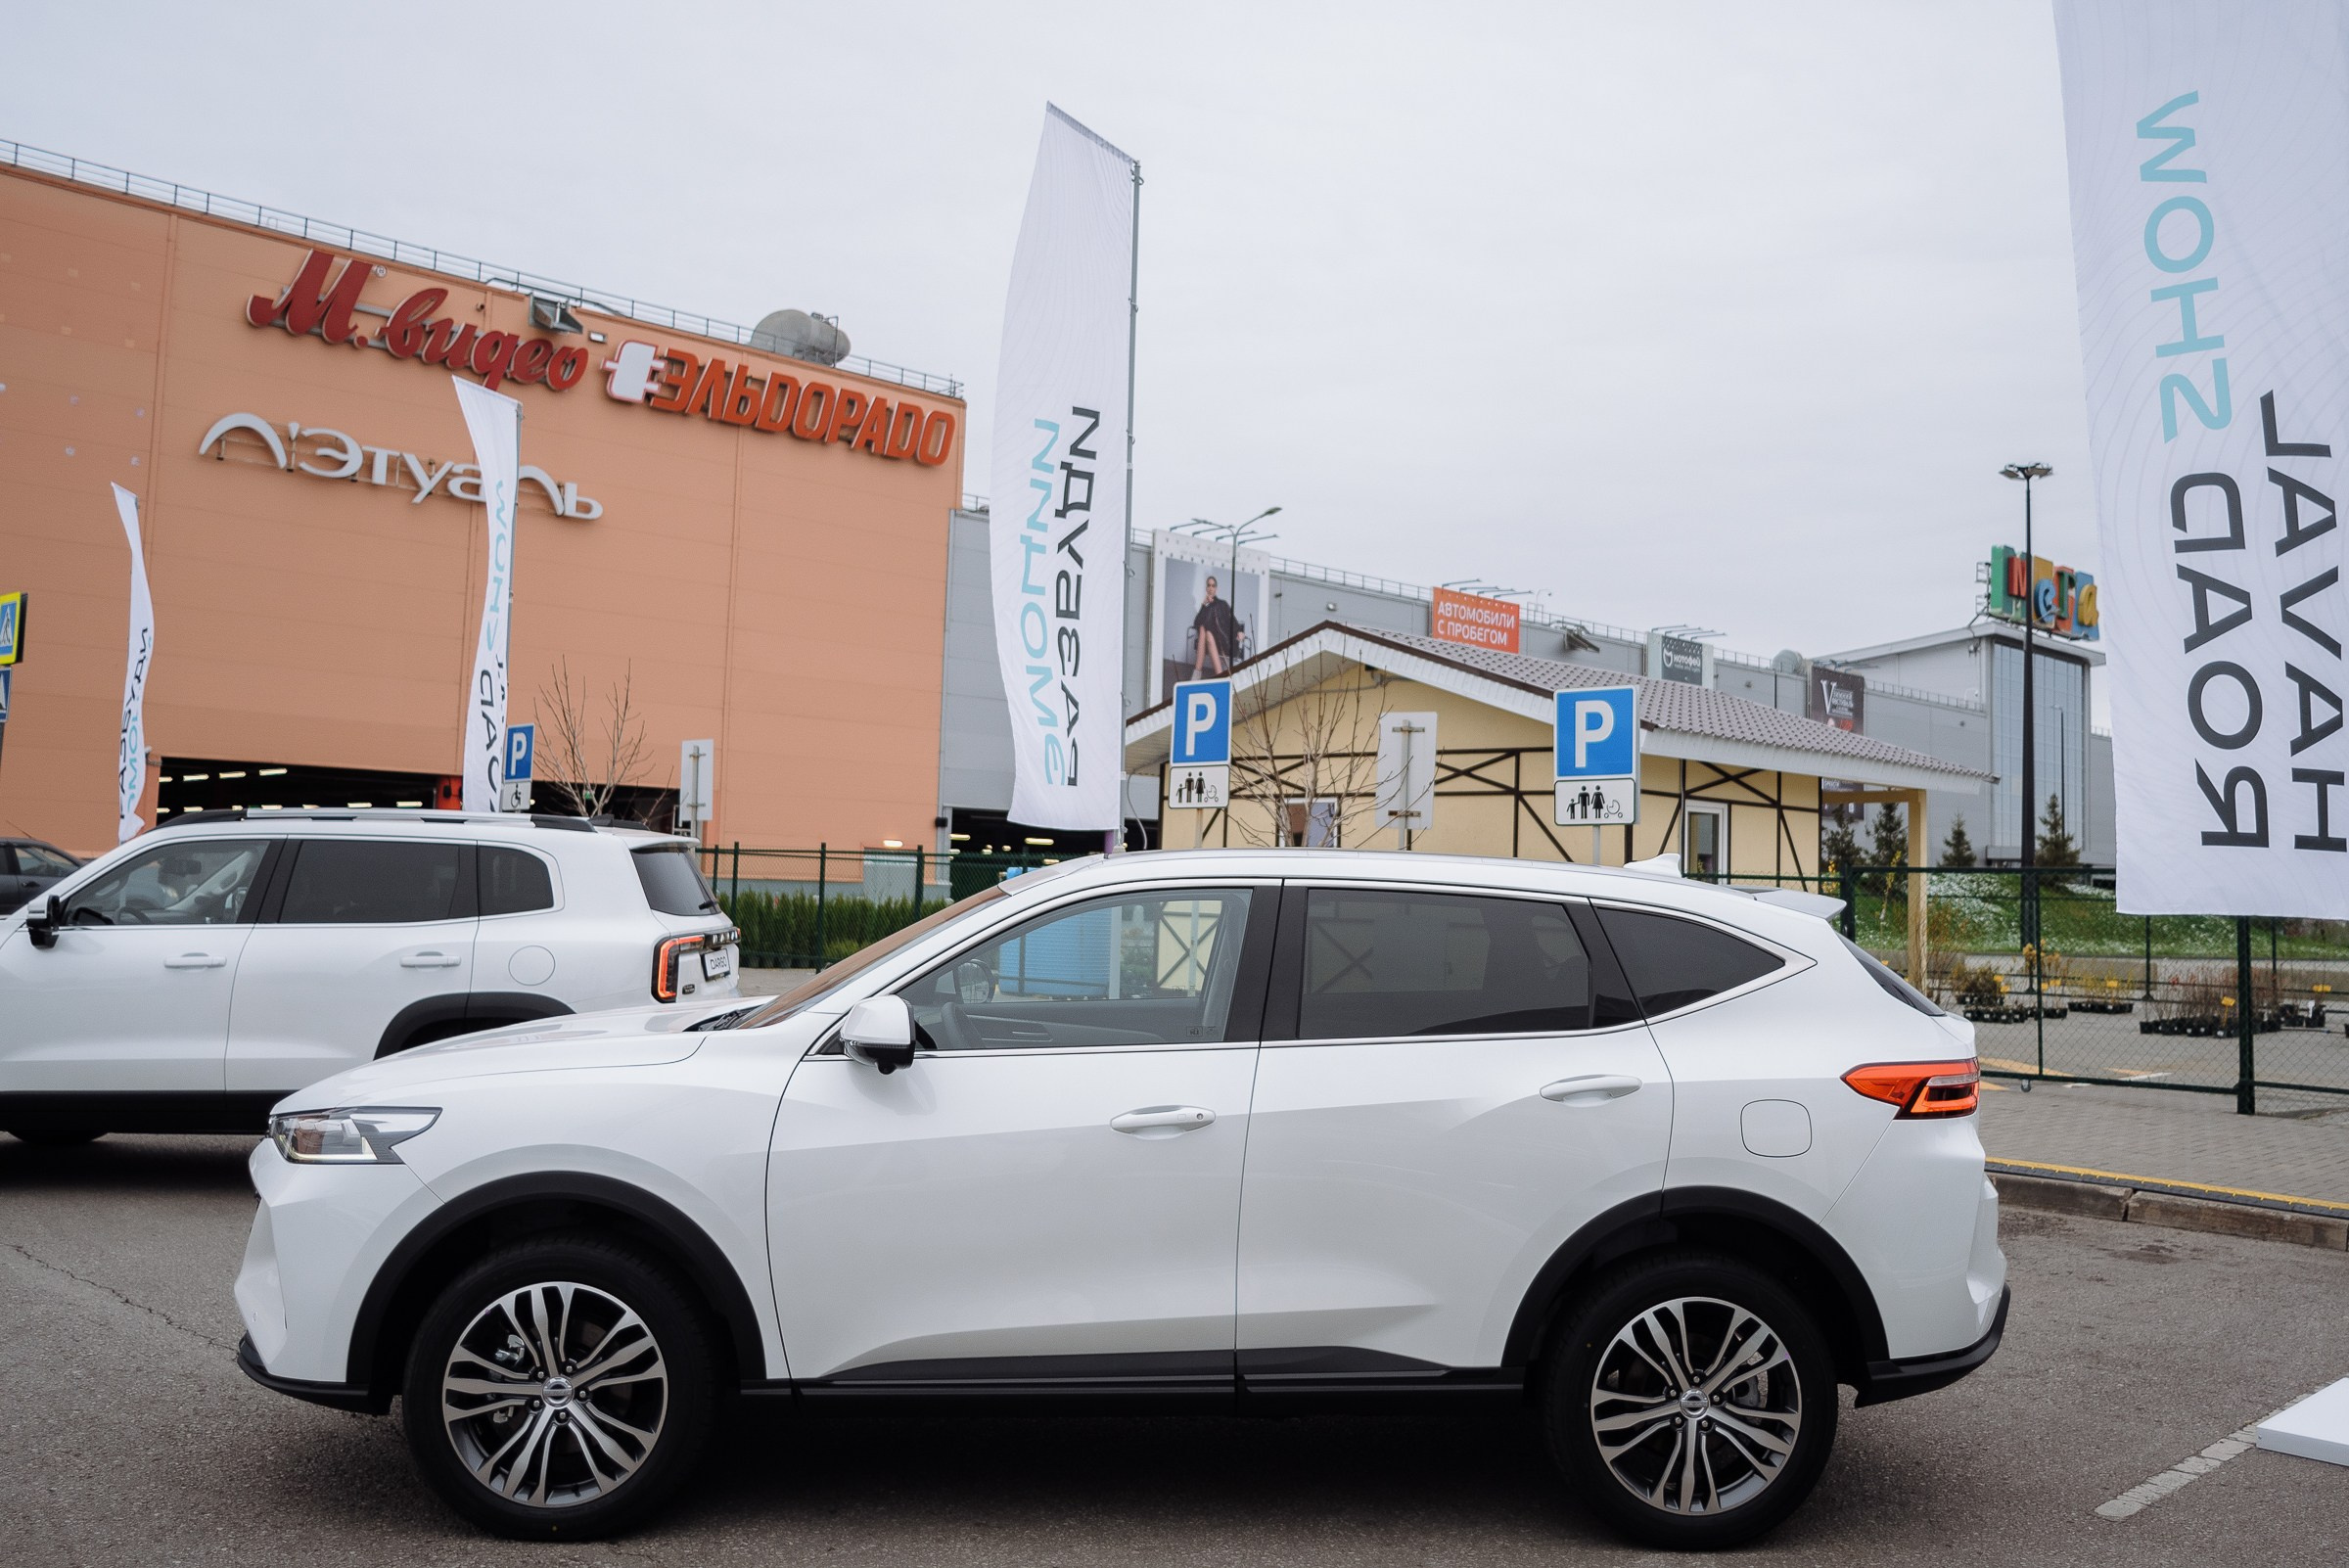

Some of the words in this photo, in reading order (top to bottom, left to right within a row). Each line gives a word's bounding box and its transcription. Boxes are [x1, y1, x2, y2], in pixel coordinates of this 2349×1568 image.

[246, 249, 589, 392] М.видео
[1437, 601, 1516, 629] АВТОМОБИЛИ
[1437, 620, 1445, 634] С
[1447, 622, 1508, 646] ПРОБЕГОМ
[1185, 692, 1217, 757] P
[1574, 700, 1614, 768] P
[510, 732, 528, 776] P
